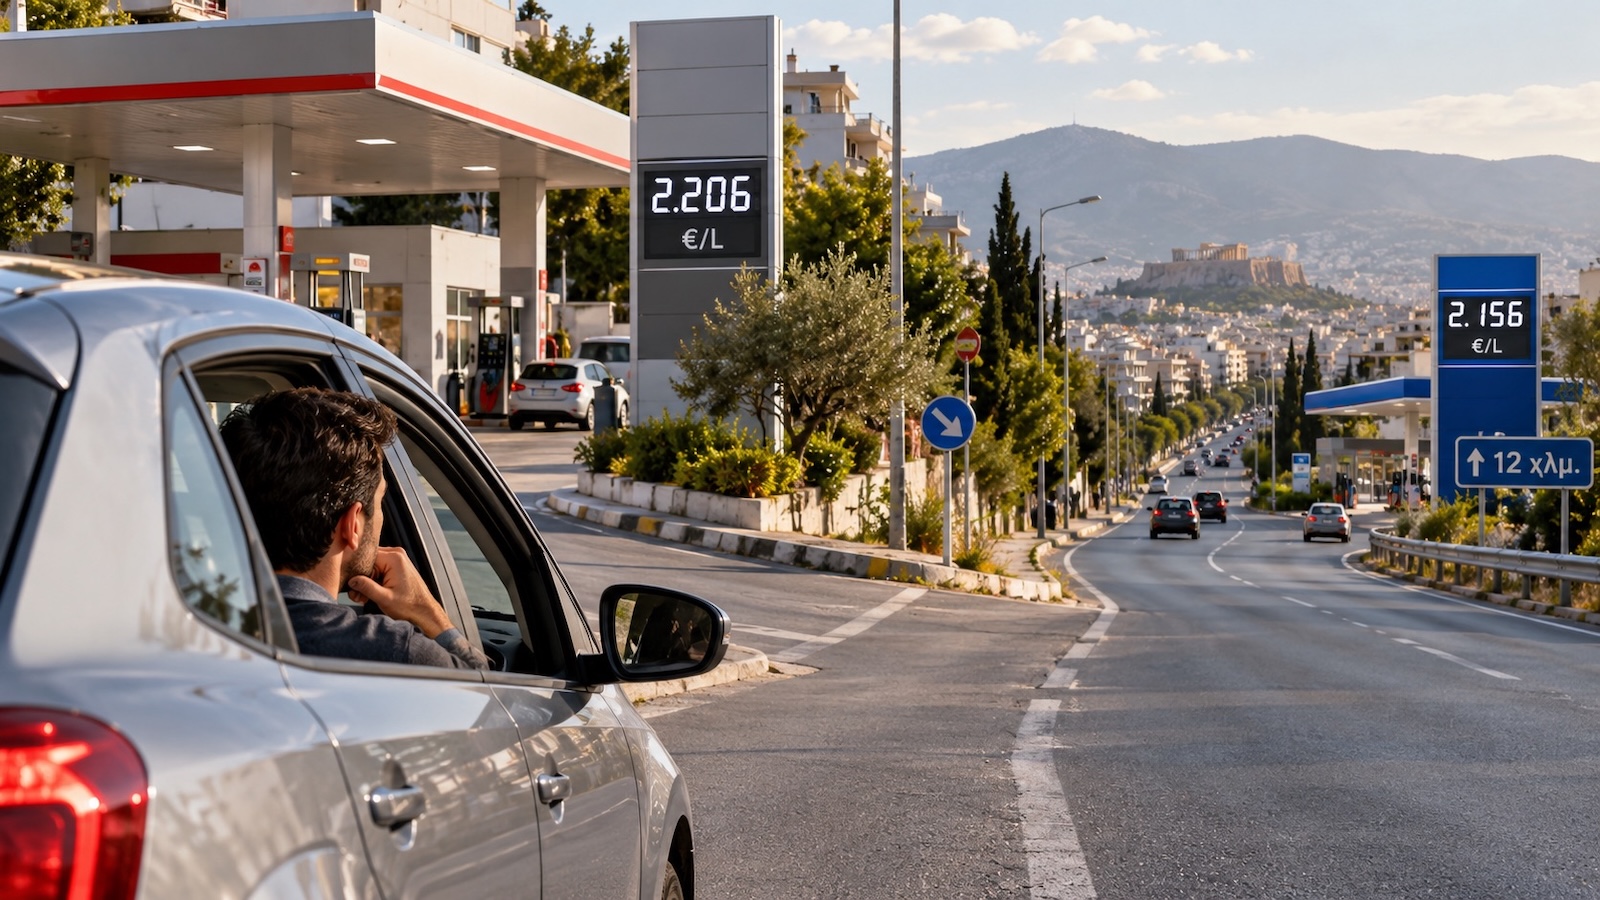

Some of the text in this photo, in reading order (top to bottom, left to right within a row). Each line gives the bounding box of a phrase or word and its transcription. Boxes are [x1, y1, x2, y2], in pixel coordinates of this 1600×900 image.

[651, 175, 751, 213] 2.206
[682, 228, 724, 250] €/L
[1448, 301, 1523, 327] 2.156
[1471, 338, 1503, 354] €/L
[1494, 451, 1580, 479] 12 χλμ.
